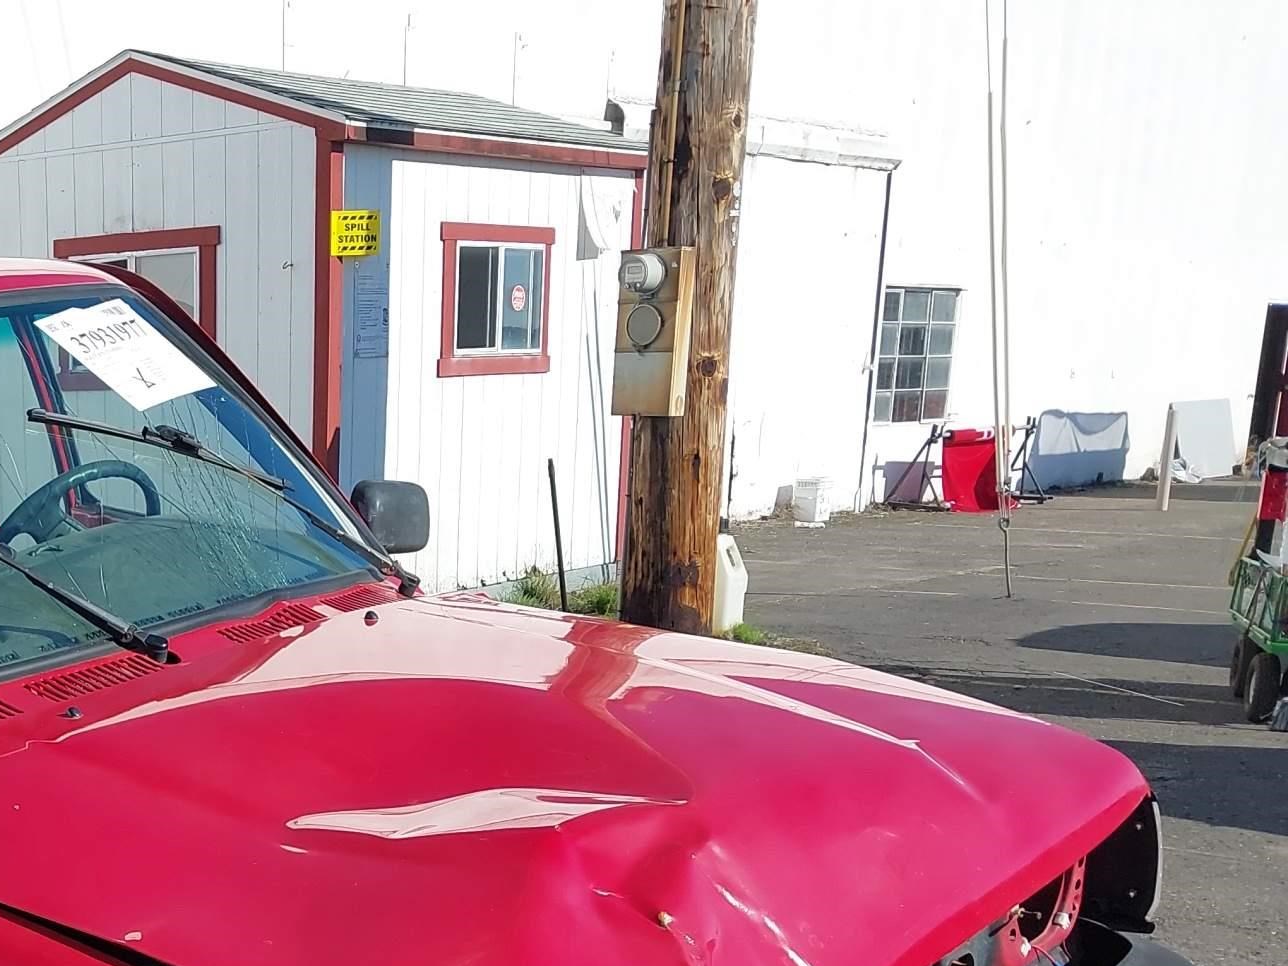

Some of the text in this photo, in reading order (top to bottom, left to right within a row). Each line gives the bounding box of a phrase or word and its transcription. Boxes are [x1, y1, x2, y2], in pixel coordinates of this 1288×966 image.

[344, 222, 371, 232] SPILL
[337, 234, 377, 243] STATION
[70, 318, 148, 354] 37931977
